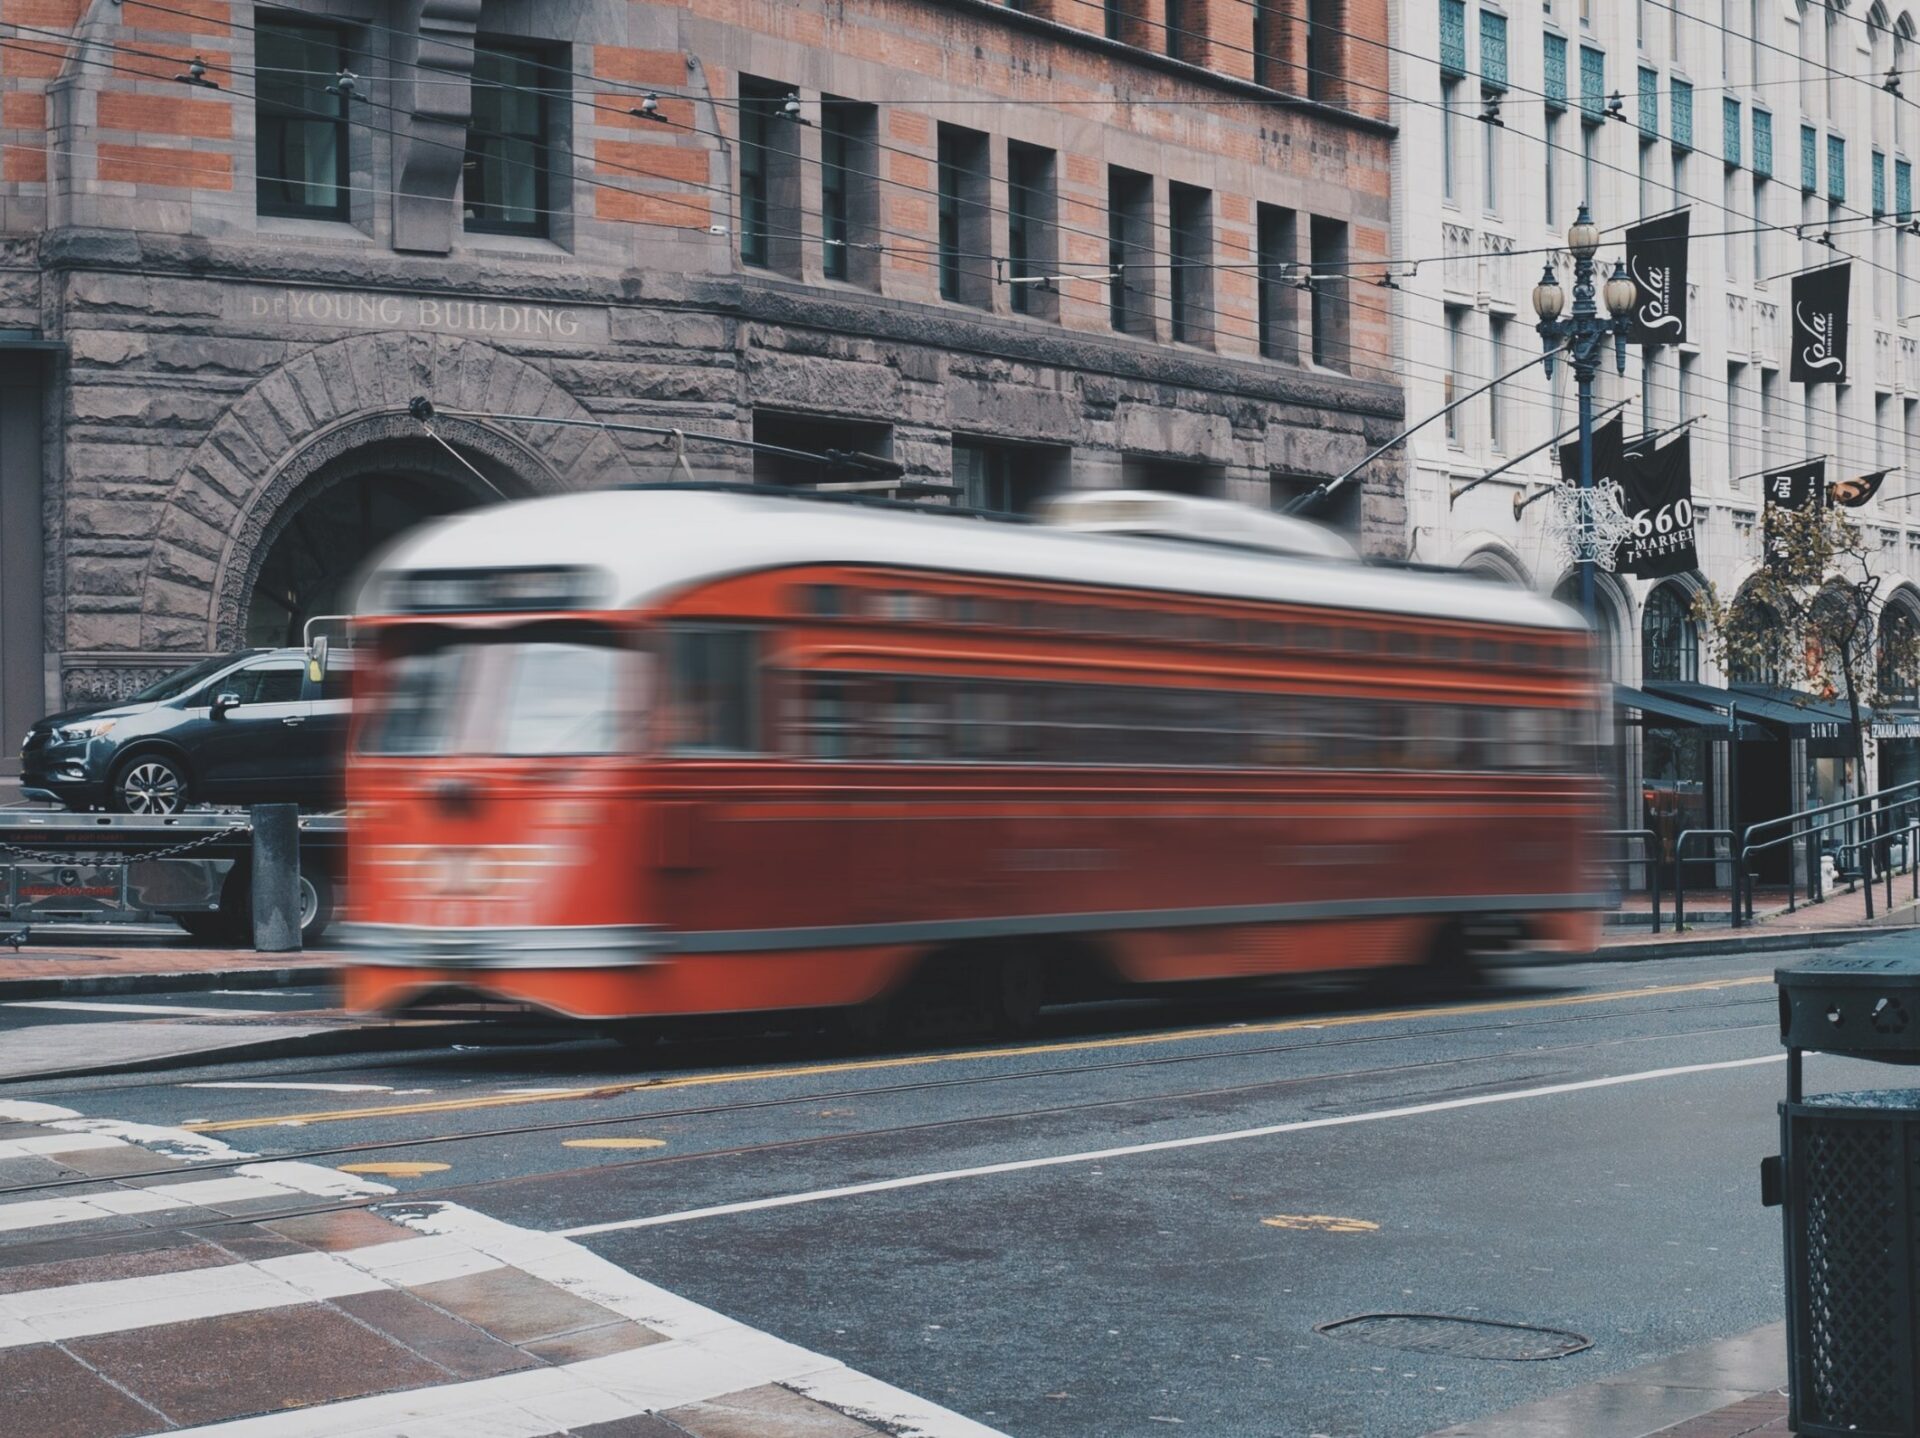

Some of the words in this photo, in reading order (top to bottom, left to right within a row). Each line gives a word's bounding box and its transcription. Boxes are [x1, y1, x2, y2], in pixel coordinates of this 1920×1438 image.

[418, 300, 579, 336] BUILDING
[1632, 498, 1693, 537] 660
[1635, 527, 1694, 550] MARKET
[1871, 724, 1896, 738] IZAKAYA
